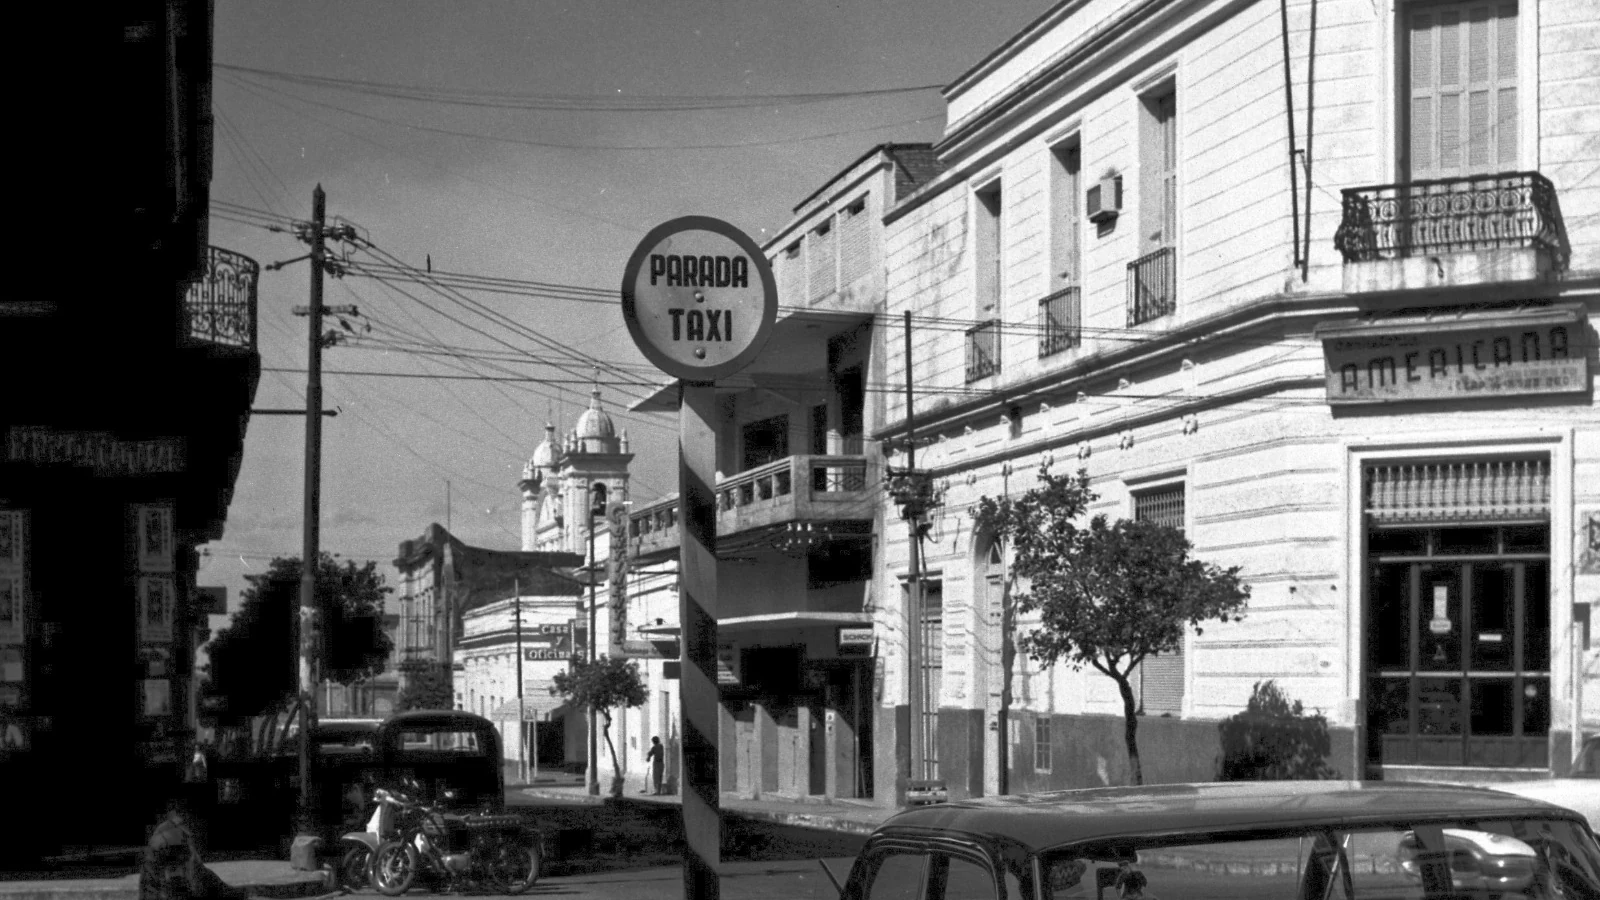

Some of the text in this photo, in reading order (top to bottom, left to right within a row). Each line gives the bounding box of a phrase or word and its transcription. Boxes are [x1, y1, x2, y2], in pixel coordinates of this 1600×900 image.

[650, 254, 748, 288] PARADA
[668, 308, 732, 342] TAXI
[1341, 326, 1569, 393] AMERICANA
[541, 625, 569, 634] Casa
